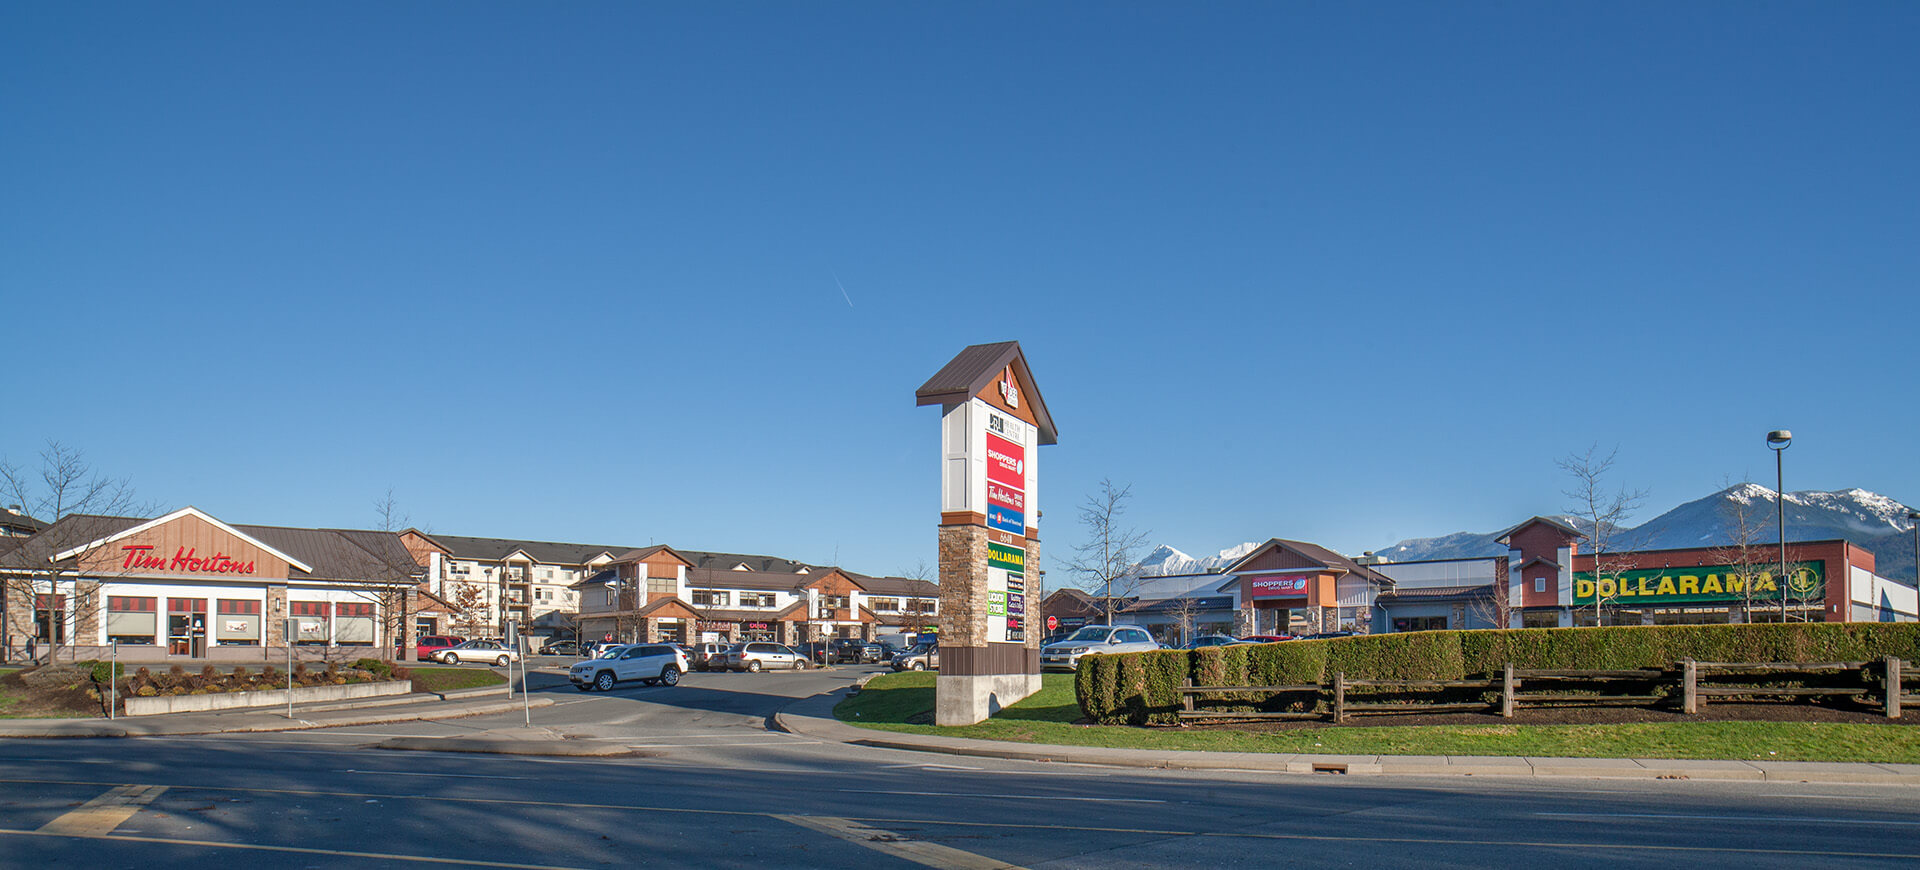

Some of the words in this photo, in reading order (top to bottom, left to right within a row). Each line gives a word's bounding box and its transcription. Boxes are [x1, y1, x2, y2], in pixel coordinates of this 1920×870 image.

[988, 449, 1016, 467] SHOPPERS
[989, 485, 998, 501] Tim
[998, 488, 1014, 505] Hortons
[121, 545, 167, 570] Tim
[170, 546, 255, 575] Hortons
[988, 549, 1023, 565] DOLLARAMA
[1252, 580, 1294, 588] SHOPPERS
[1576, 570, 1778, 598] DOLLARAMA
